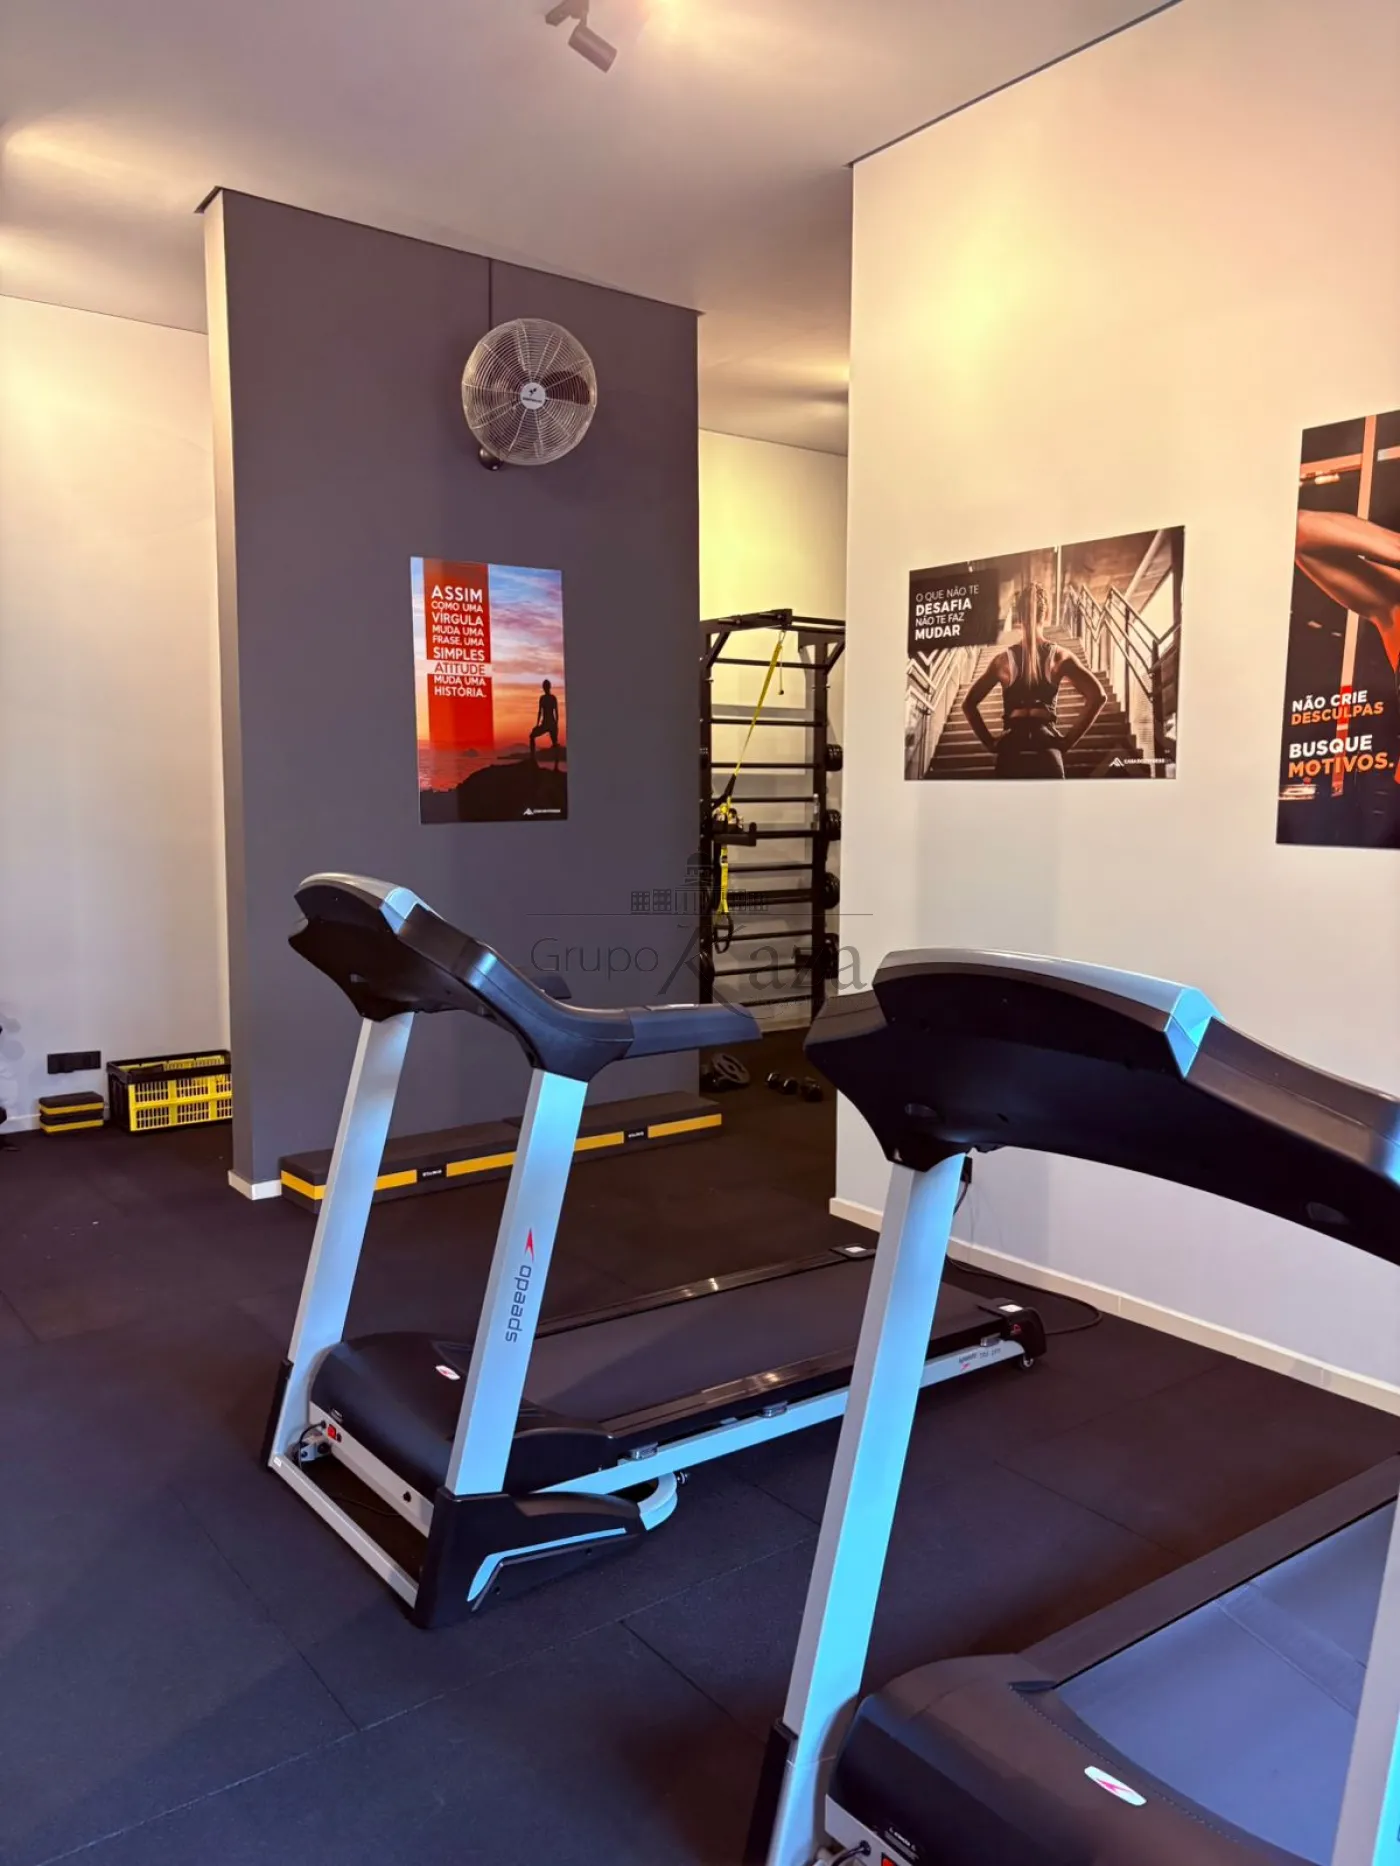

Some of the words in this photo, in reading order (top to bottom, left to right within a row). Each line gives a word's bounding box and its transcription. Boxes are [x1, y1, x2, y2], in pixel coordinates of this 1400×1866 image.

[431, 584, 483, 603] ASSIM
[915, 593, 924, 602] O
[925, 590, 944, 602] QUE
[946, 585, 967, 598] NÃO
[969, 584, 980, 595] TE
[431, 600, 460, 611] COMO
[462, 602, 484, 613] UMA
[915, 597, 973, 617] DESAFIA
[431, 608, 485, 627] VÍRGULA
[915, 615, 935, 627] NÃO
[935, 614, 947, 625] TE
[947, 611, 965, 623] FAZ
[432, 624, 461, 635] MUDA
[462, 627, 485, 637] UMA
[914, 624, 961, 641] MUDAR
[463, 637, 485, 647] UMA
[433, 646, 486, 662] SIMPLES
[434, 662, 486, 676] ATITUDE
[433, 674, 463, 686] MUDA
[464, 676, 487, 687] UMA
[434, 683, 488, 698] HISTÓRIA.
[1291, 694, 1327, 713] NÃO
[1329, 690, 1369, 708] CRIE
[1290, 701, 1385, 726] DESCULPAS
[1288, 734, 1374, 759] BUSQUE
[1287, 752, 1395, 779] MOTIVOS.
[504, 1264, 533, 1343] speedo
